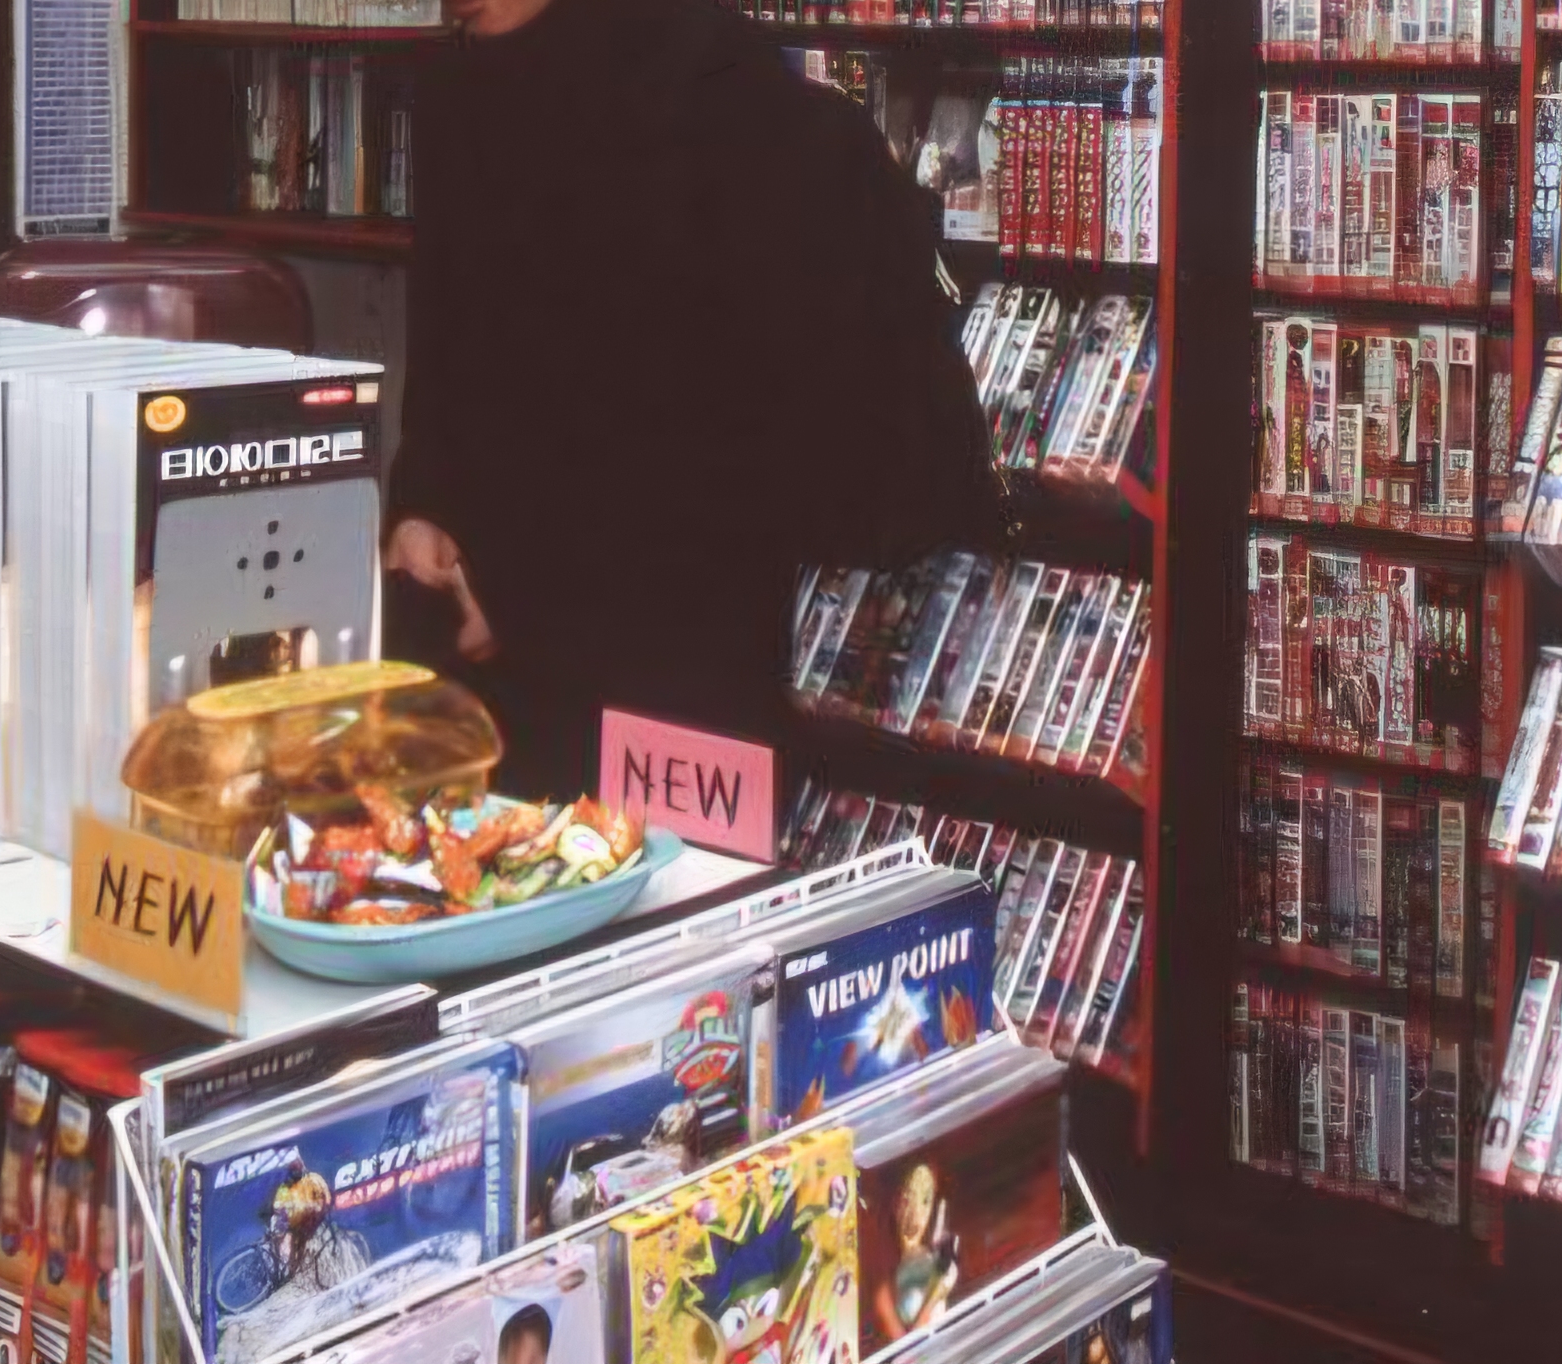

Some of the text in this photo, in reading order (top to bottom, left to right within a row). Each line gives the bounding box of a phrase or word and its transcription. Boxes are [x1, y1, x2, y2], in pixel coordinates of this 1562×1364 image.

[621, 747, 742, 830] NEW
[94, 854, 215, 958] NEW
[807, 960, 885, 1019] VIEW
[889, 927, 974, 992] POINT
